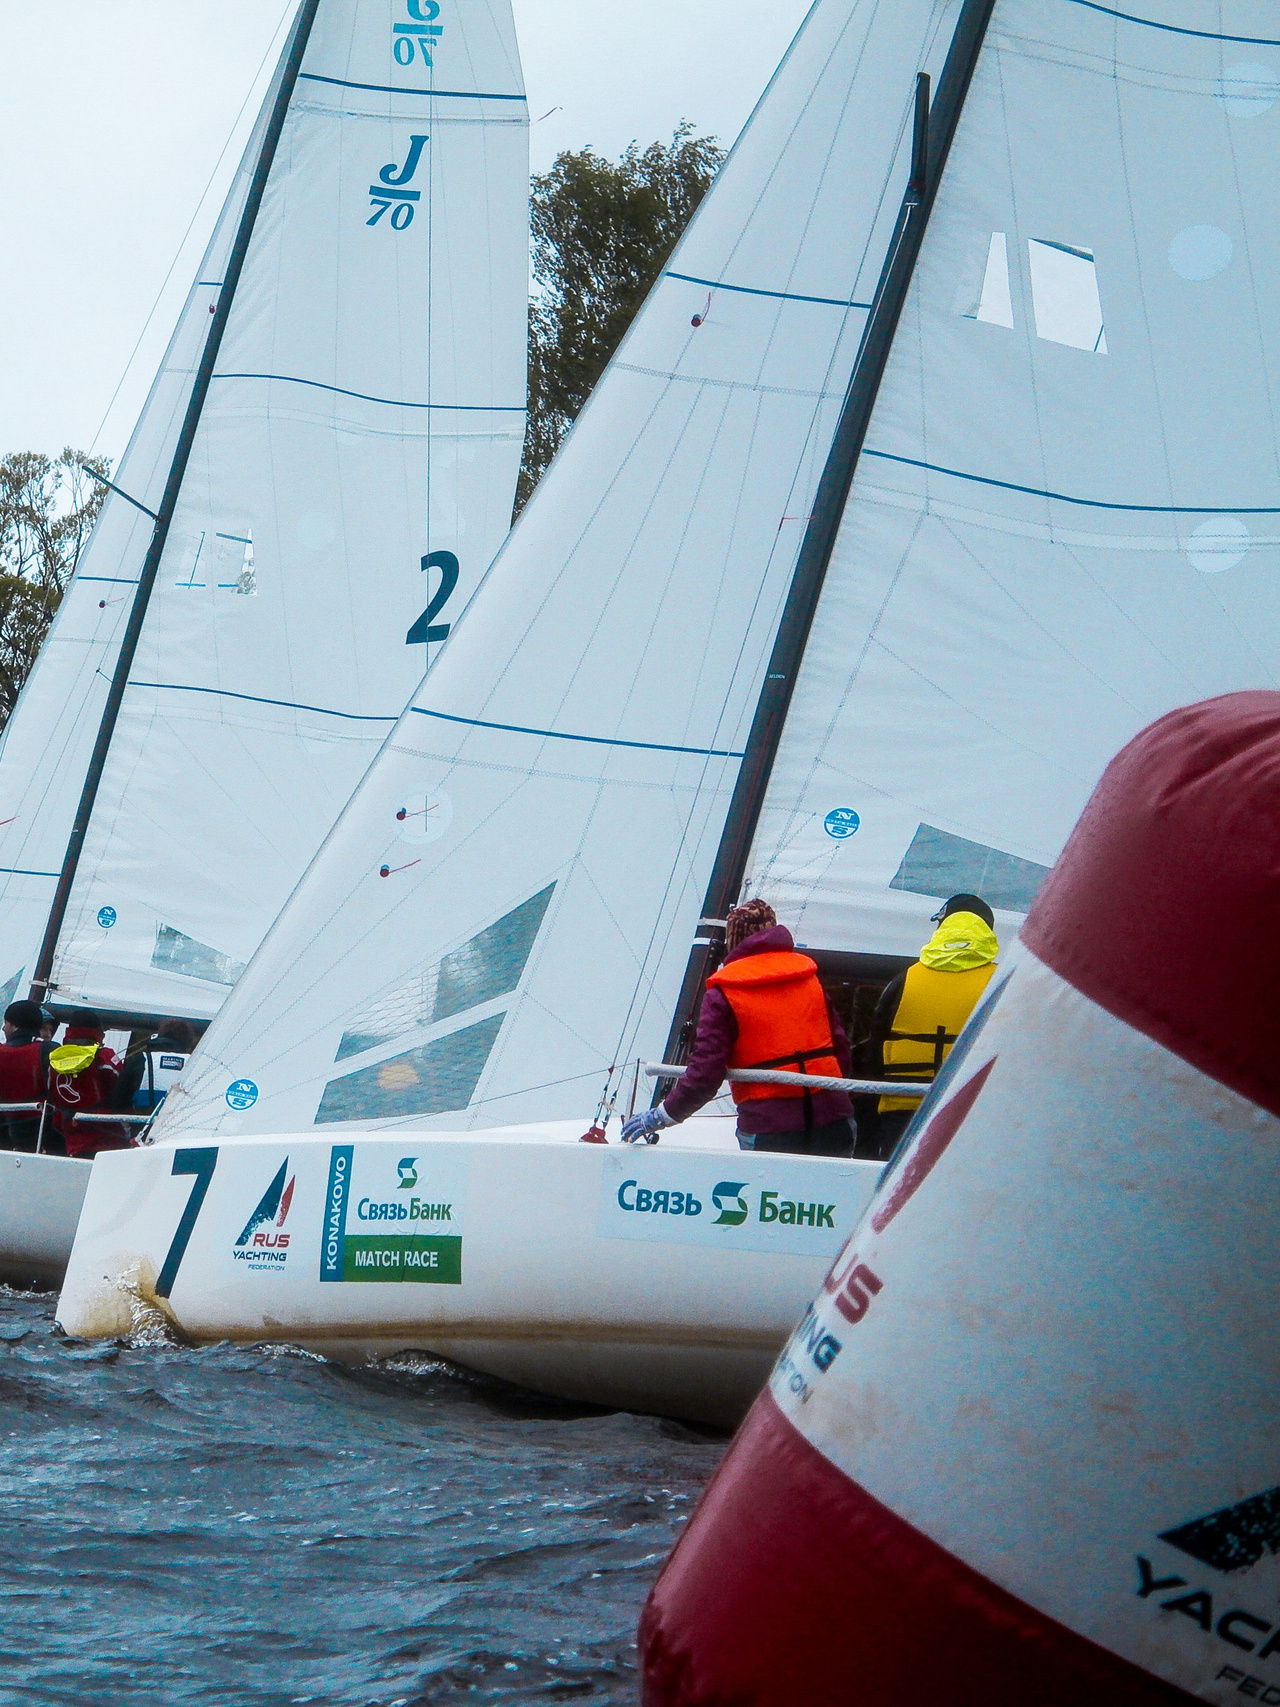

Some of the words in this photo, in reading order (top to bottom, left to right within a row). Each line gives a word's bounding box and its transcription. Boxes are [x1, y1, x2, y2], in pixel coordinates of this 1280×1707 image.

[379, 135, 429, 185] J
[365, 198, 415, 230] 70
[405, 550, 460, 645] 2
[154, 1147, 219, 1299] 7
[326, 1156, 347, 1270] KONAKOVO
[617, 1179, 703, 1216] Связь
[758, 1191, 837, 1228] Банк
[232, 1250, 287, 1262] YACHTING
[252, 1233, 291, 1248] RUS
[355, 1250, 400, 1267] MATCH
[403, 1251, 439, 1268] RACE
